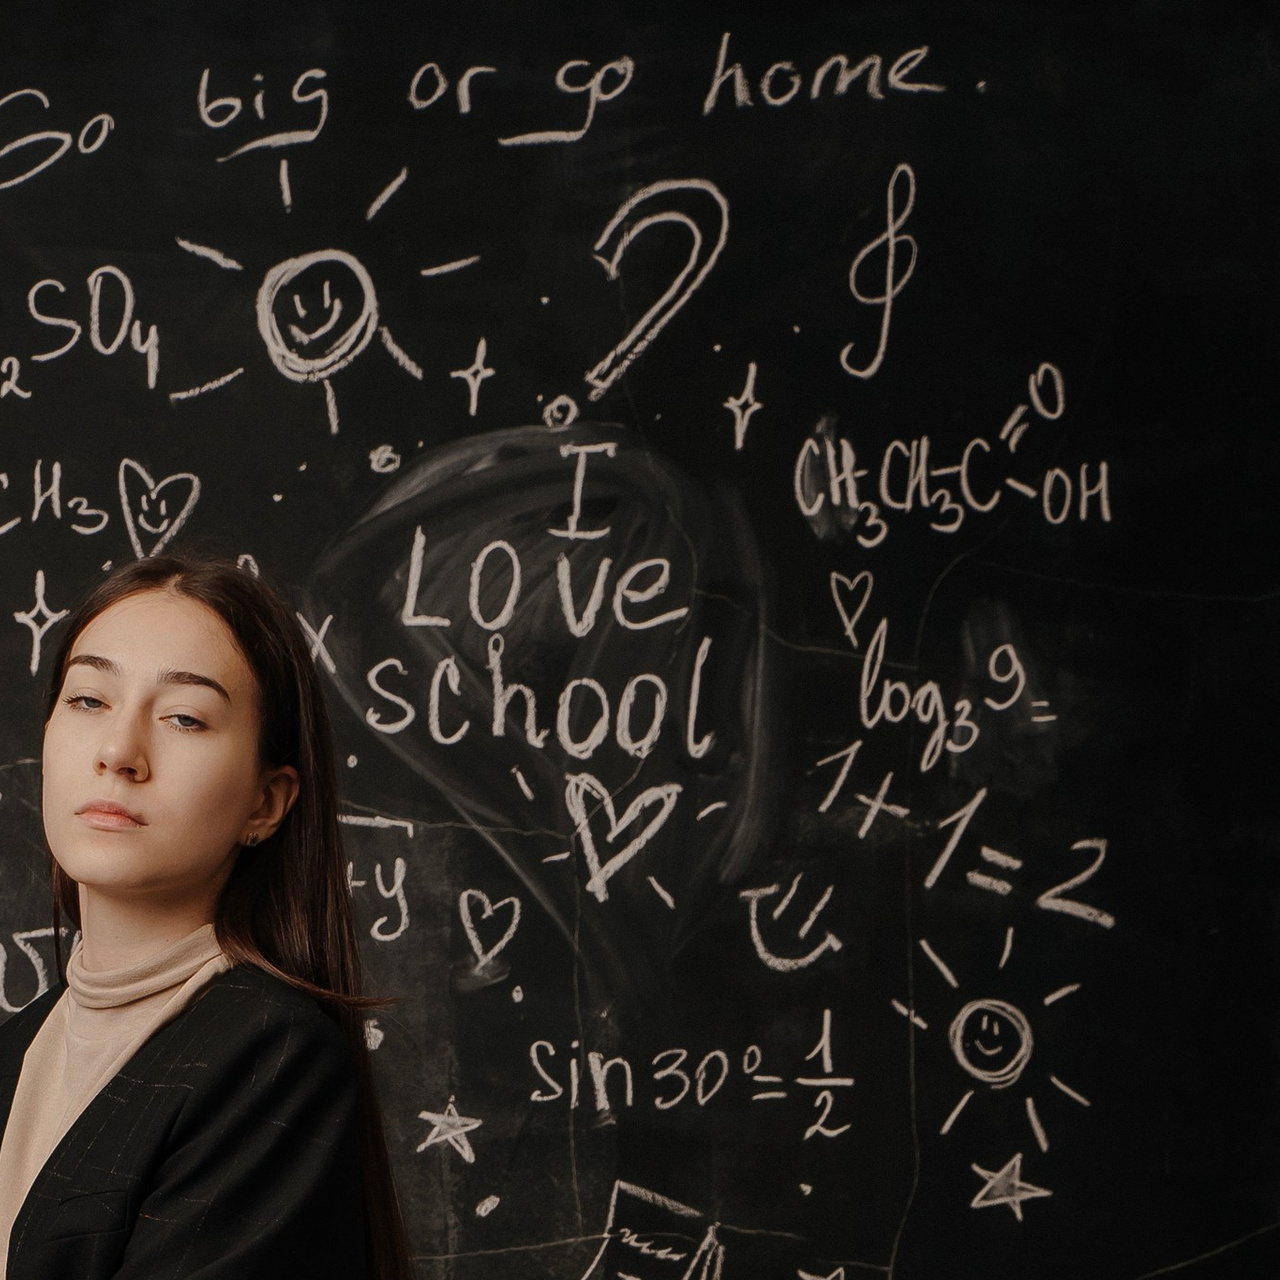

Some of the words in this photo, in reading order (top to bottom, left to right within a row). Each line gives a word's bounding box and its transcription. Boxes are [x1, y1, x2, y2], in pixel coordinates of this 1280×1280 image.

[198, 68, 328, 162] big
[410, 61, 496, 113] or
[497, 57, 635, 145] go
[547, 442, 617, 540] I
